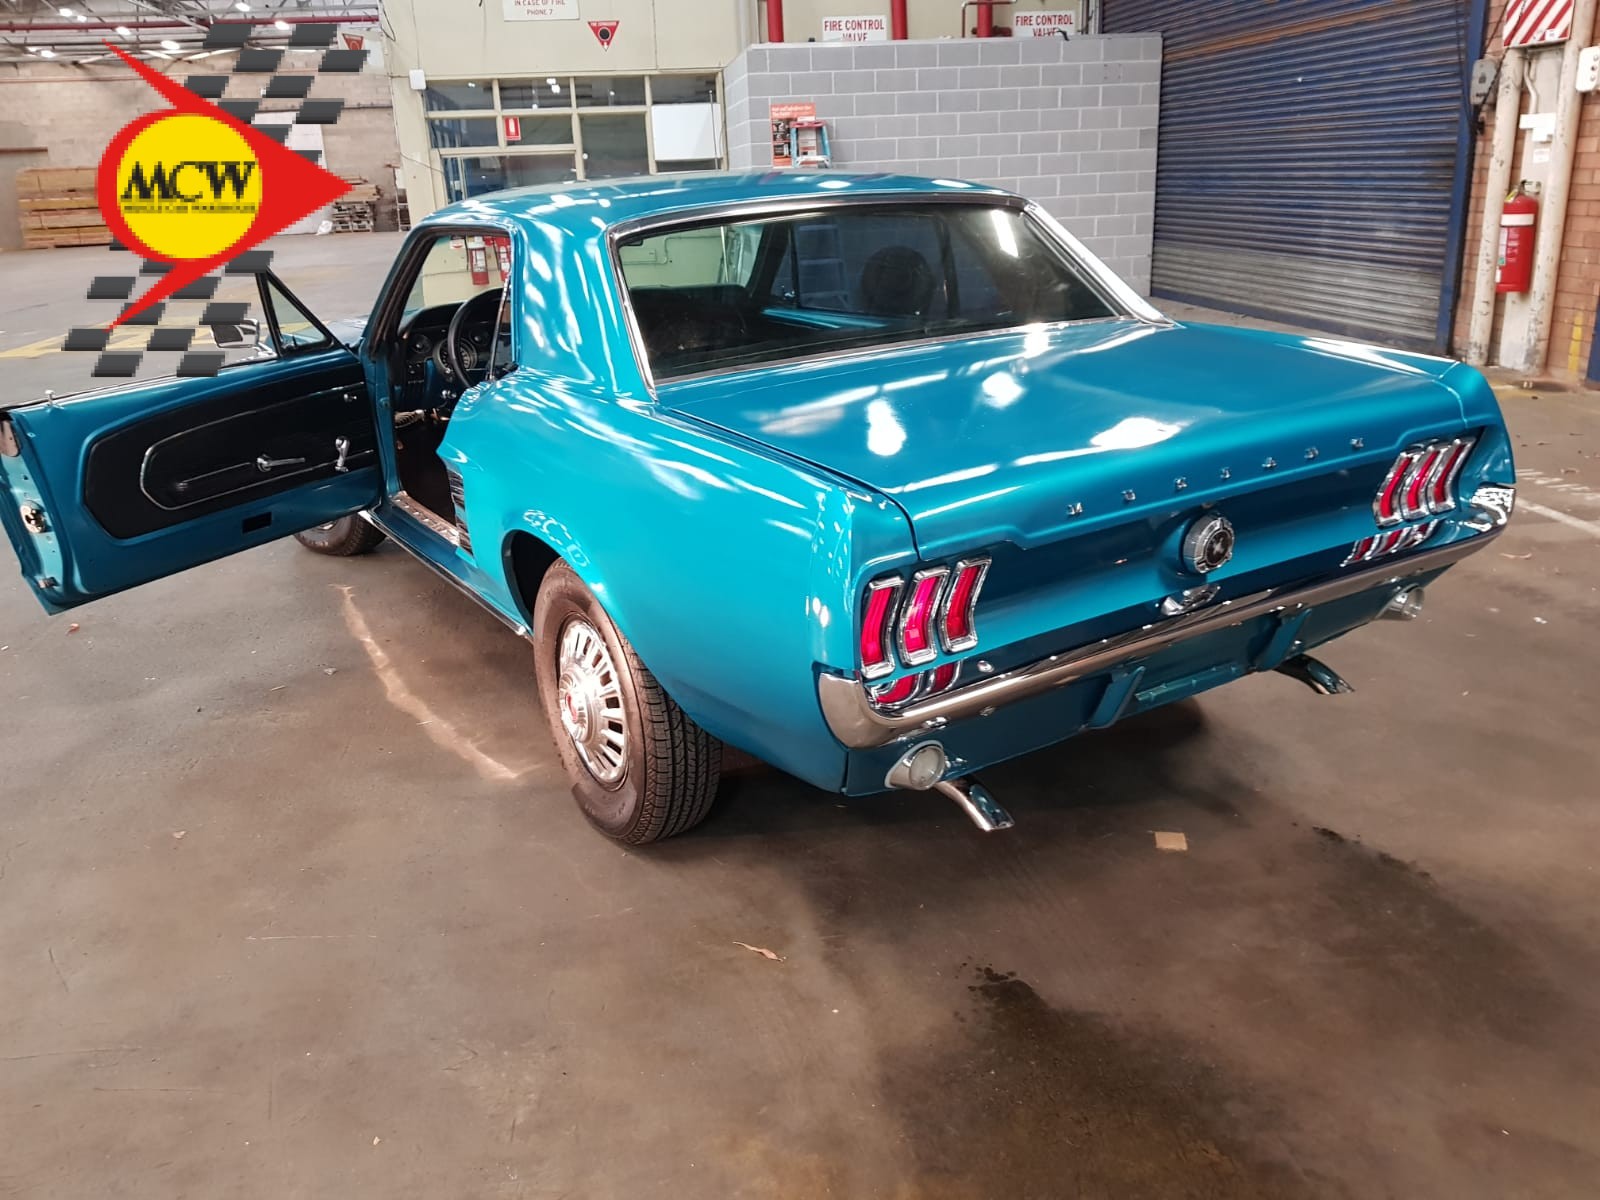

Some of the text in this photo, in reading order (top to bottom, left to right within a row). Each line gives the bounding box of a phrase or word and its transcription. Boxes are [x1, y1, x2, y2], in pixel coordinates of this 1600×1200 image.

[824, 19, 884, 31] FIRE CONTROL
[1016, 14, 1073, 26] FIRE CONTROL
[1033, 27, 1057, 37] VALVE
